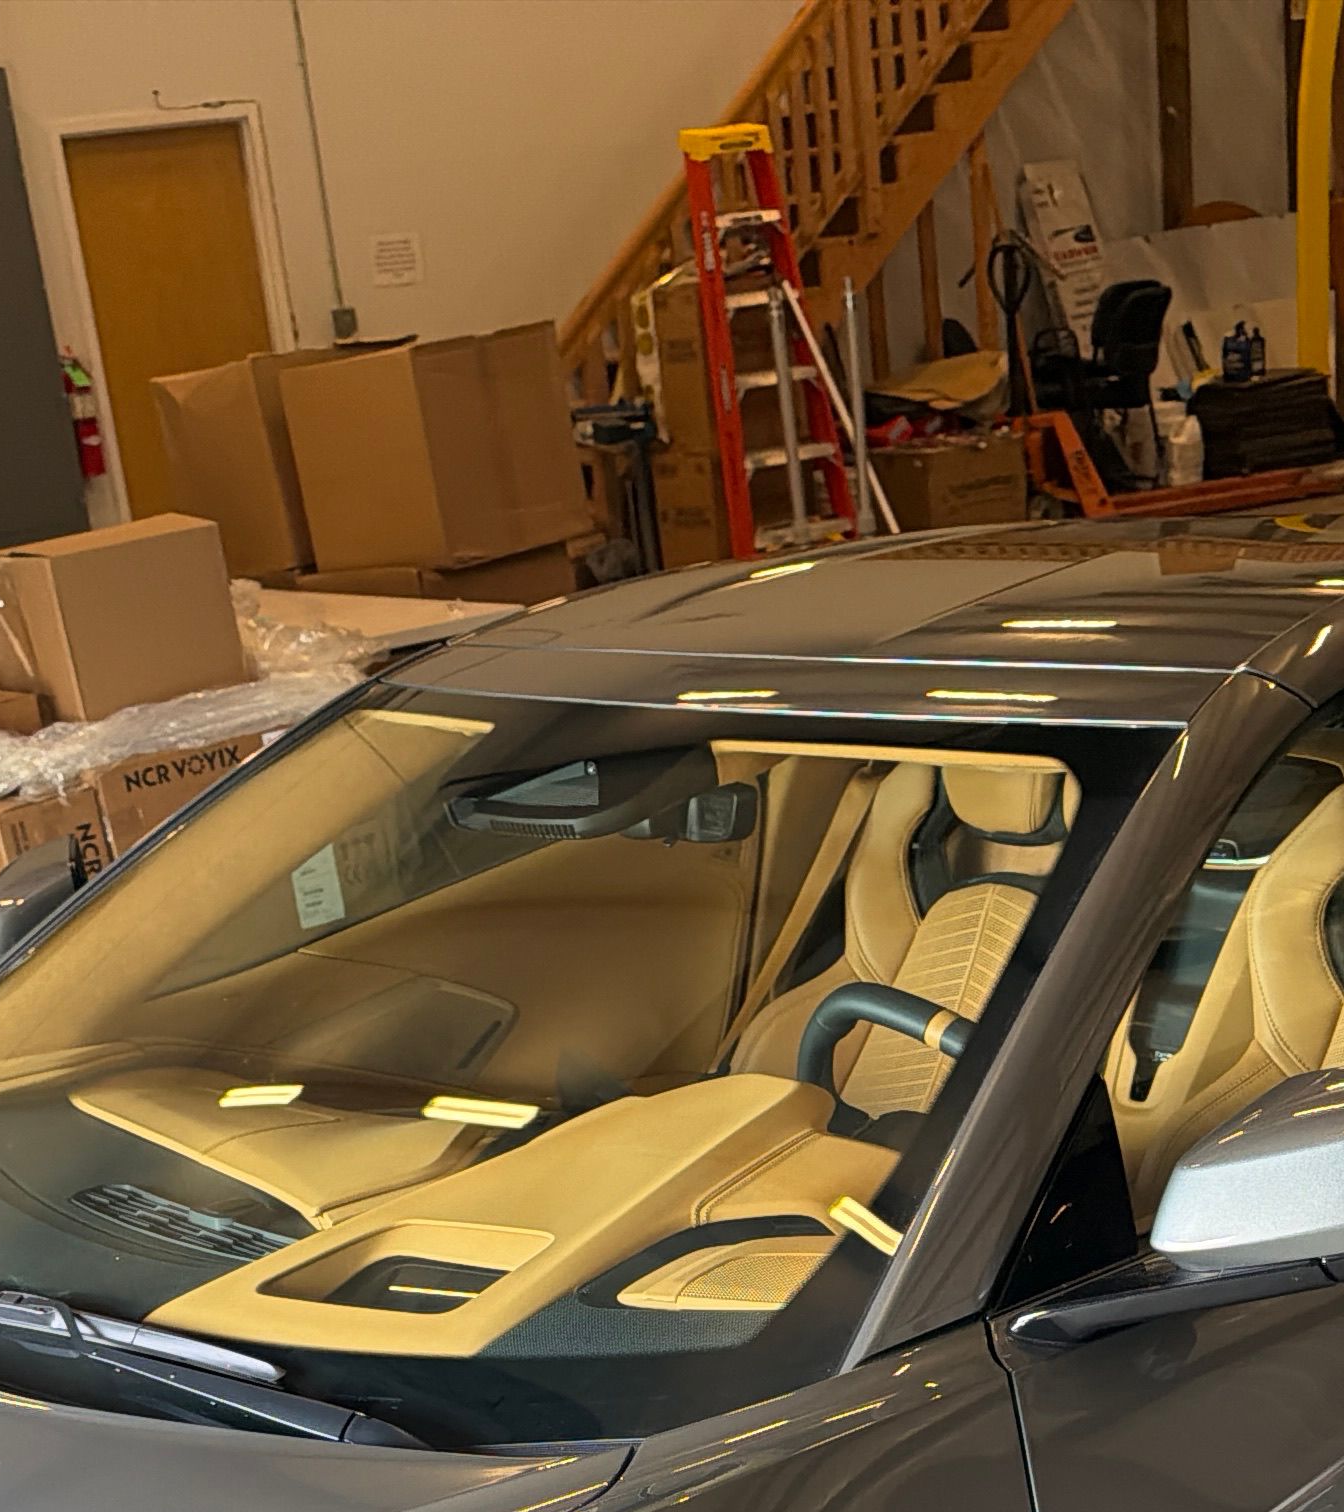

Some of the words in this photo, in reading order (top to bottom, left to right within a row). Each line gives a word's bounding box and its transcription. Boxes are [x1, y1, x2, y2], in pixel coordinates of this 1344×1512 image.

[123, 763, 172, 793] NCR
[171, 744, 243, 780] VOYIX
[75, 822, 104, 875] NCR
